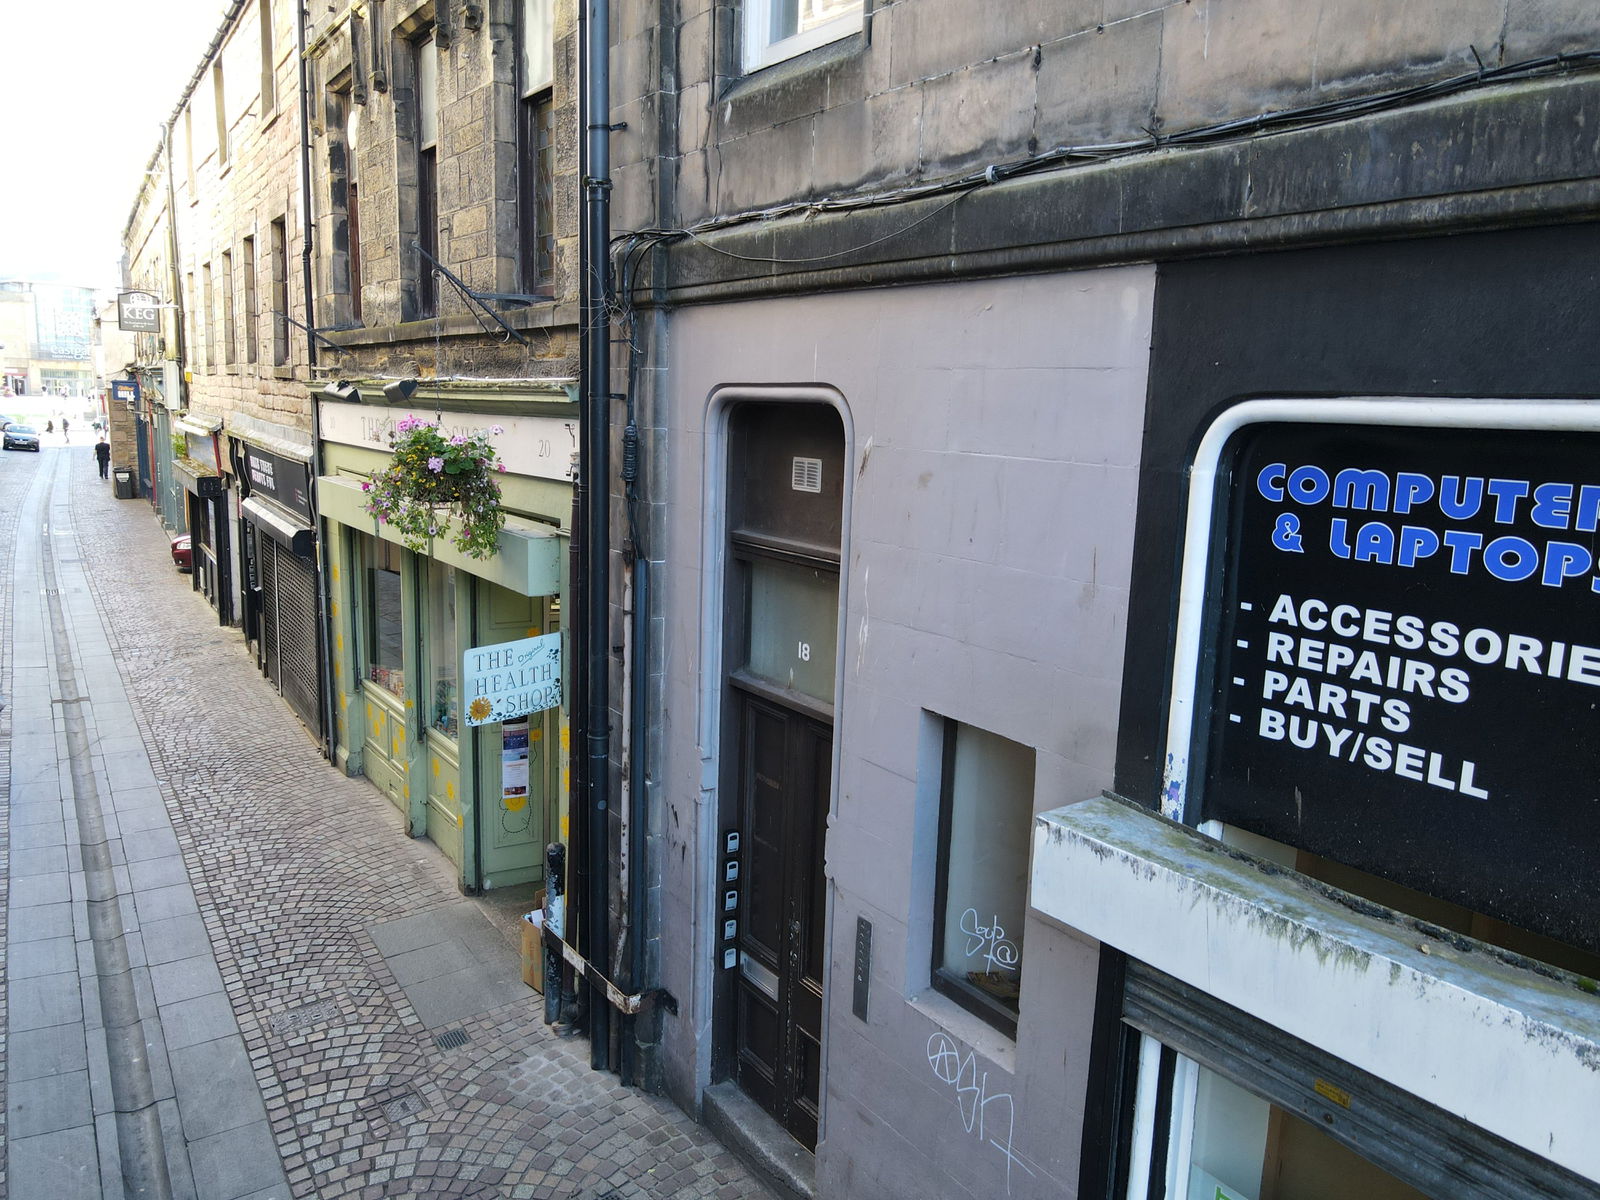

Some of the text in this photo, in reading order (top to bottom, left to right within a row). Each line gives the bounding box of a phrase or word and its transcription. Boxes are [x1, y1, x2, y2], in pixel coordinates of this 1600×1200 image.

[122, 304, 154, 320] KEG
[538, 440, 551, 457] 20
[1271, 512, 1600, 594] & LAPTOP
[473, 648, 514, 672] THE
[798, 641, 810, 661] 18
[474, 662, 552, 697] HEALTH
[1266, 631, 1470, 704] REPAIRS
[505, 685, 554, 714] SHOP
[1262, 669, 1411, 733] PARTS
[1258, 707, 1489, 800] BUY/SELL
